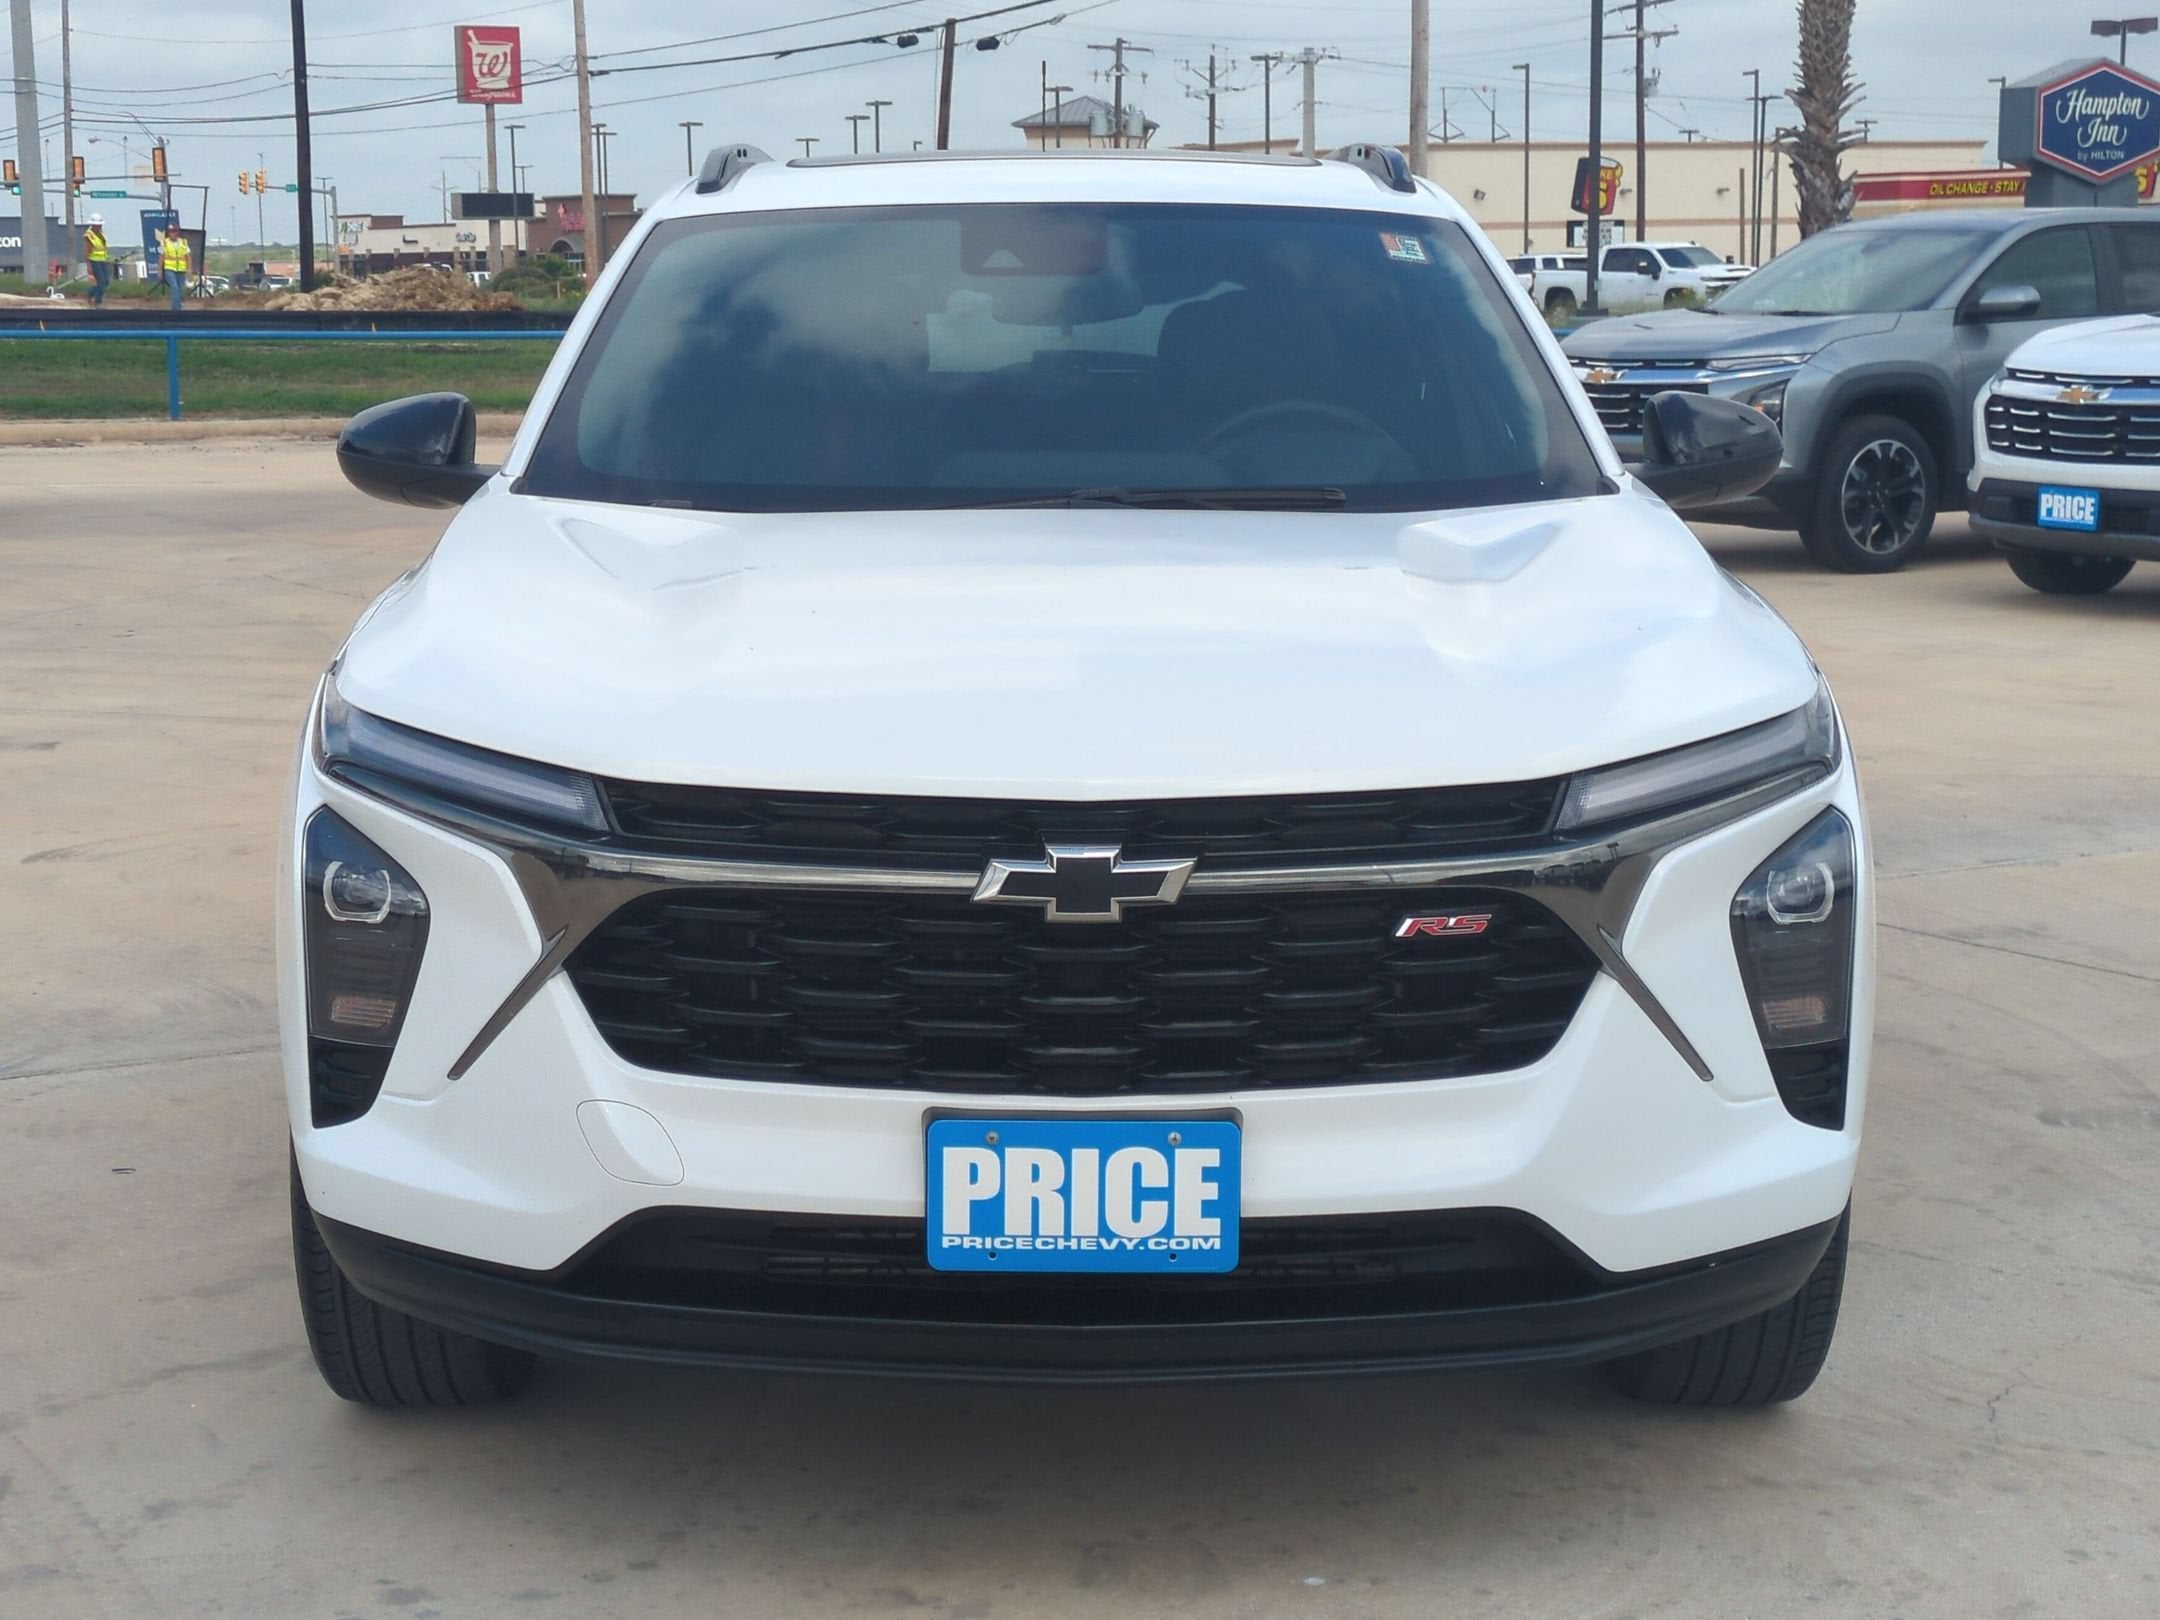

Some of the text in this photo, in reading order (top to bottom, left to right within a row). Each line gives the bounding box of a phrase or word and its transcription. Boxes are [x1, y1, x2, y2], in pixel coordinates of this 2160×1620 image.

[2055, 88, 2150, 123] Hampton
[2077, 116, 2127, 148] Inn
[2077, 149, 2125, 162] by HILTON
[1930, 184, 1945, 195] OIL
[1946, 181, 1990, 194] CHANGE
[1995, 180, 2020, 193] STAY
[2040, 493, 2095, 522] PRICE
[1395, 914, 1492, 937] RS
[942, 1146, 1221, 1238] PRICE
[942, 1236, 1221, 1250] PRICECHEVY.COM
